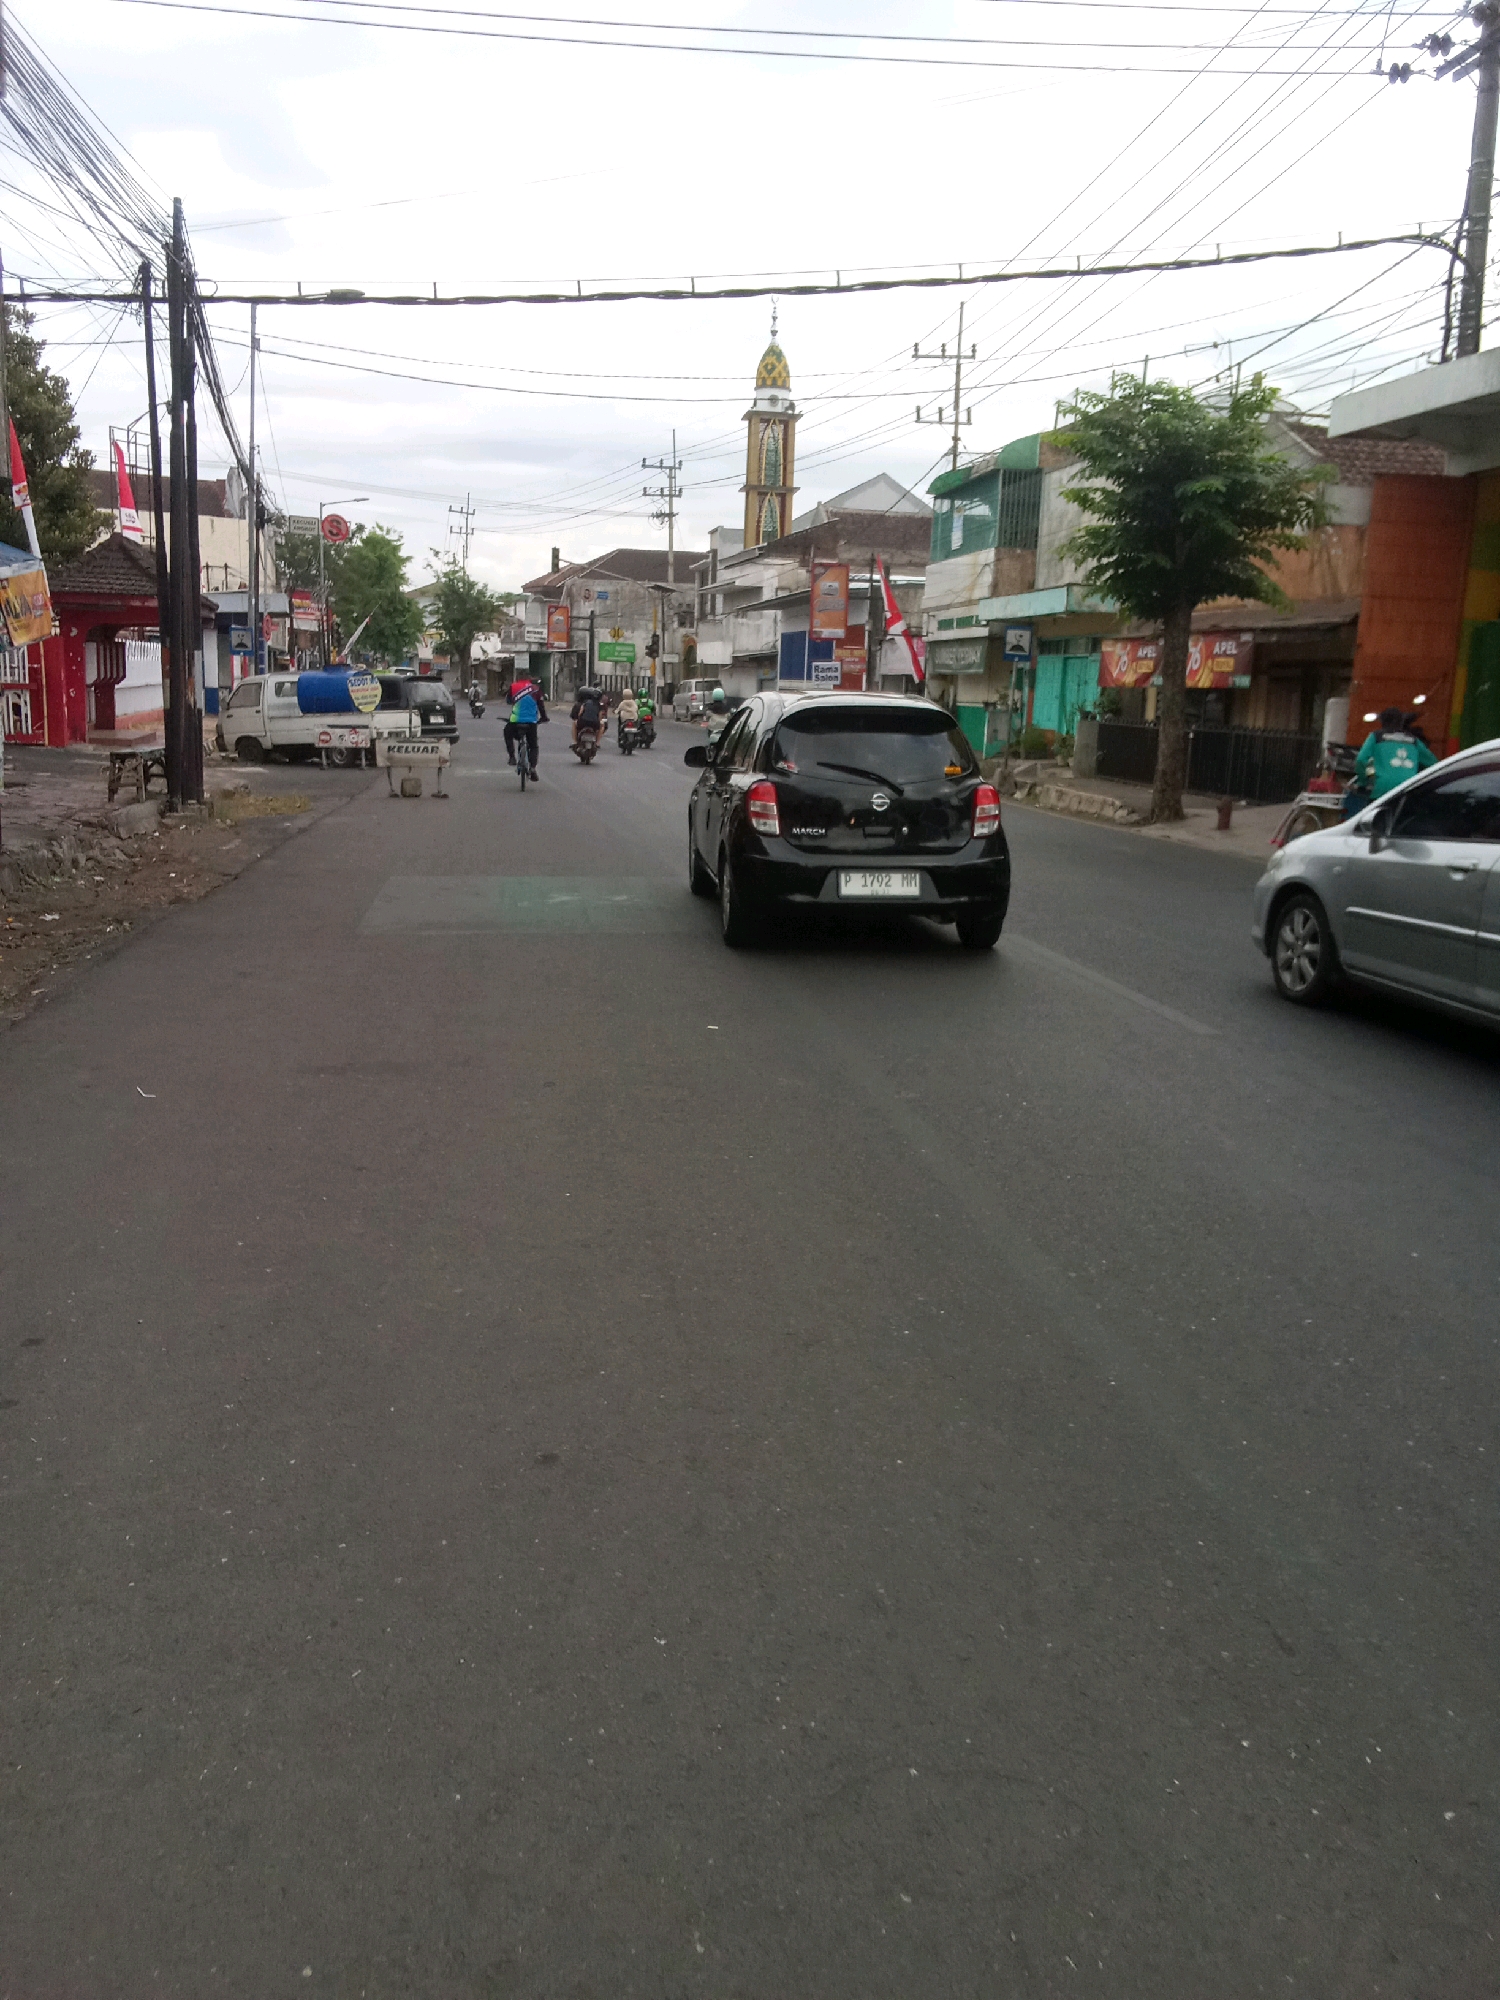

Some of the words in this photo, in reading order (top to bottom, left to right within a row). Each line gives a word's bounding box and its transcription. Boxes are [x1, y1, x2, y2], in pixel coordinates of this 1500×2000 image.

[1137, 645, 1157, 658] APEL
[1213, 641, 1238, 655] APEL
[814, 665, 839, 674] Rama
[350, 677, 368, 687] SEDOT
[815, 674, 839, 682] Salon
[387, 745, 440, 754] KELUAR
[792, 827, 826, 836] MARCH
[844, 874, 852, 888] P
[861, 874, 892, 888] 1792
